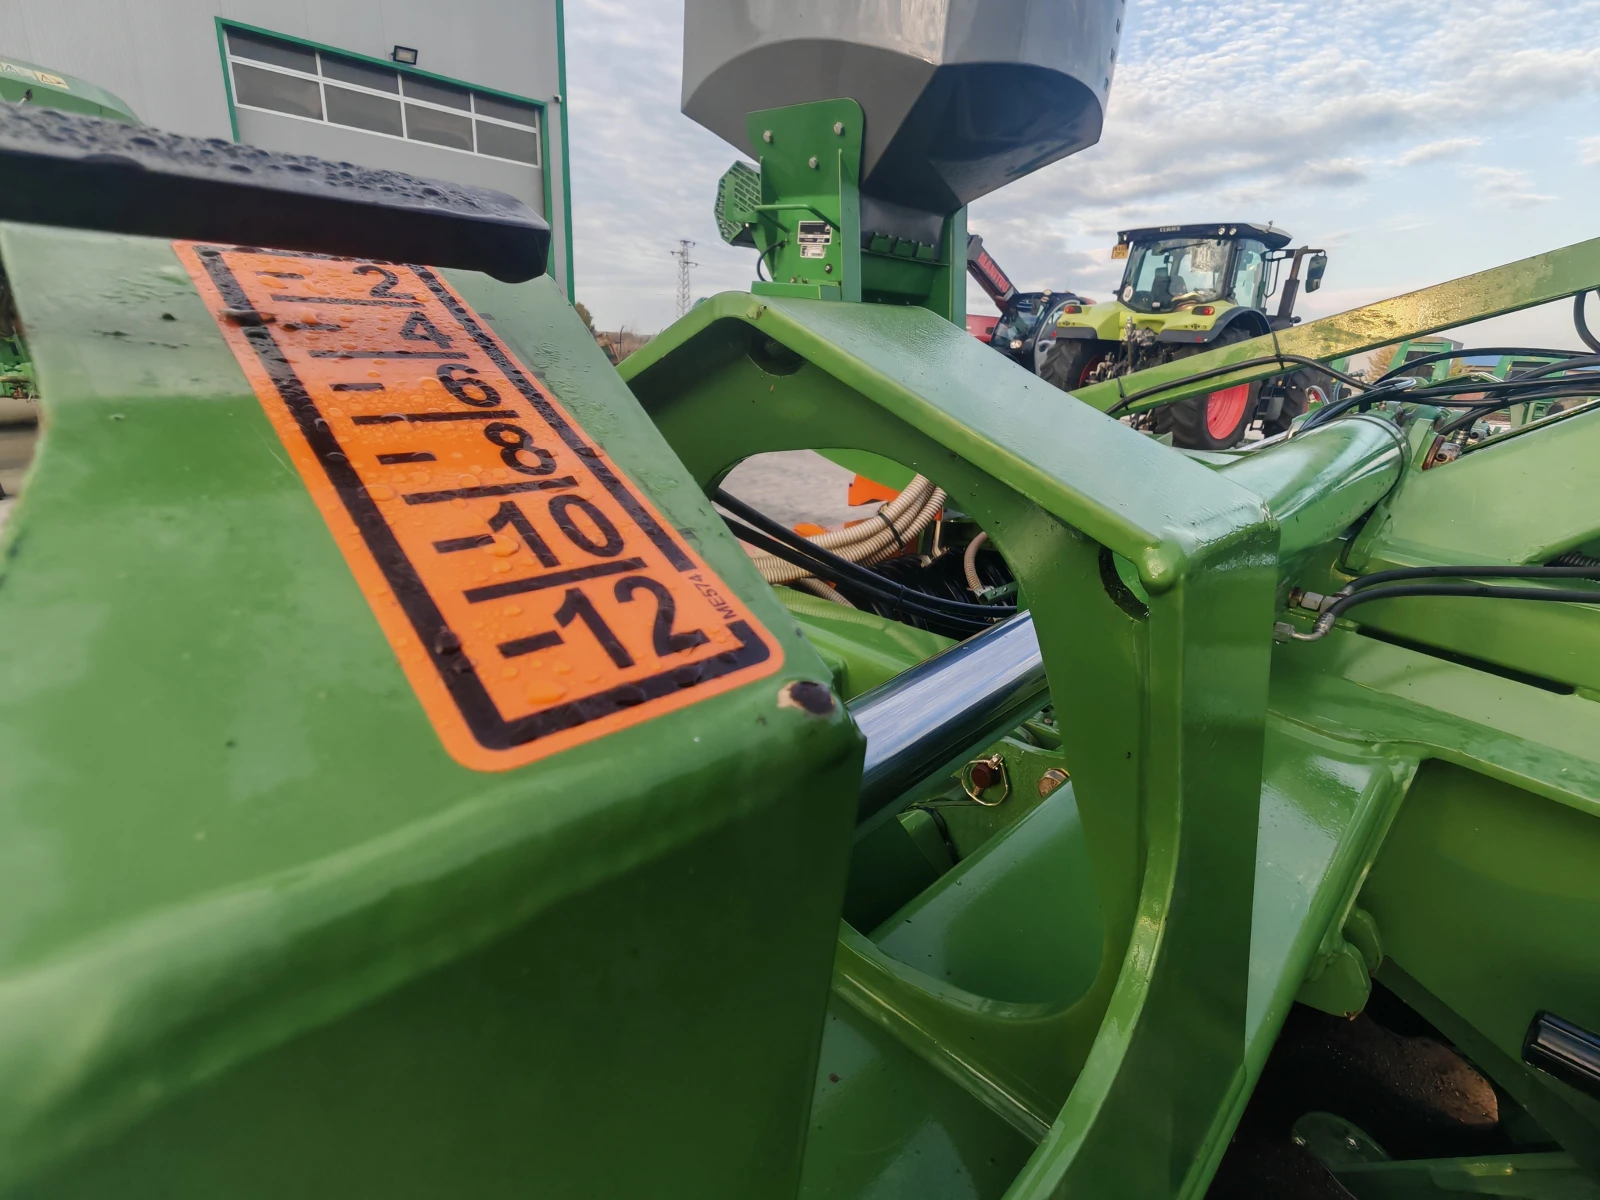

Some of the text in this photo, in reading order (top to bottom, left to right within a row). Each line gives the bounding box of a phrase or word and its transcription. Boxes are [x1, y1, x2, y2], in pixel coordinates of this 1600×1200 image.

[352, 265, 416, 300] 2
[977, 251, 1010, 293] MANITOU
[399, 310, 454, 350] 4
[436, 363, 502, 408] 6
[484, 421, 557, 476] 8
[488, 494, 625, 568] 10
[688, 573, 738, 620] ME574
[553, 576, 710, 670] 12
